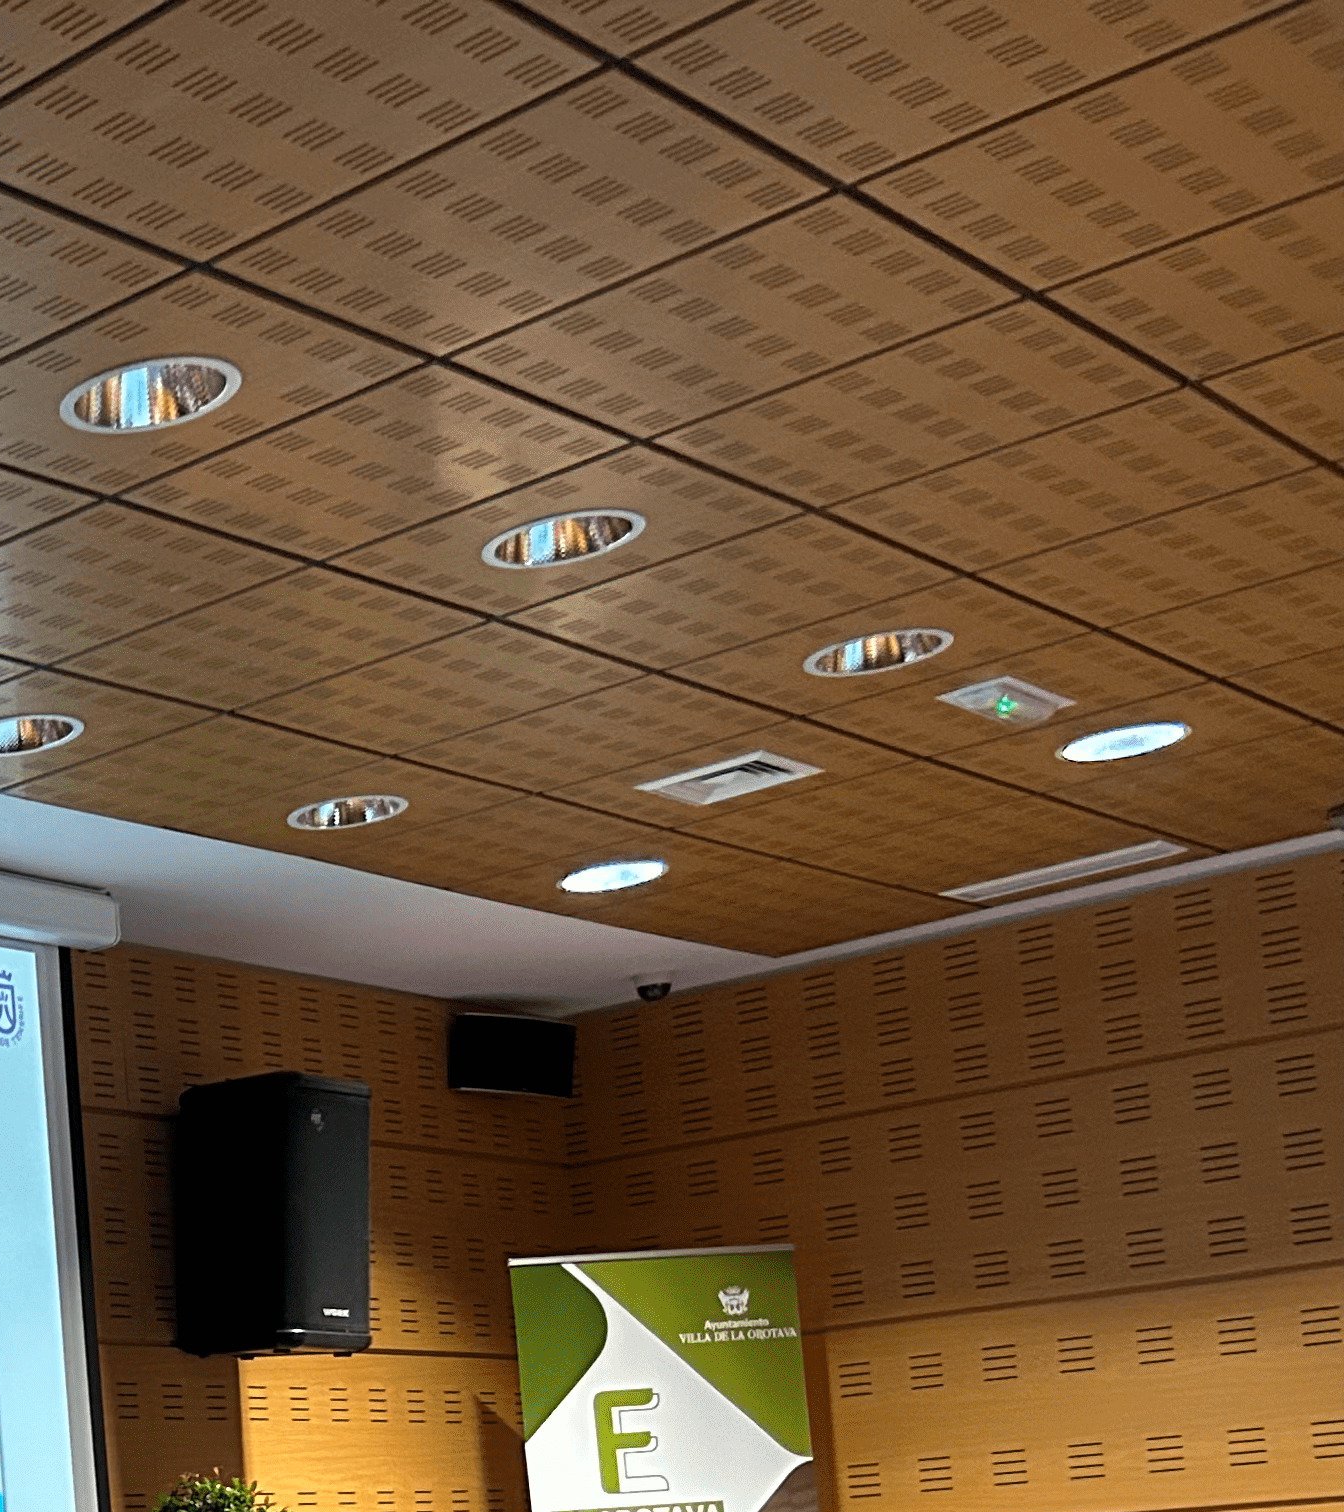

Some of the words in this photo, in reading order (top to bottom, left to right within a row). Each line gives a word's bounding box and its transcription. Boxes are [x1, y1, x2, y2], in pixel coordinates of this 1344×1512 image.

[678, 1332, 712, 1344] VILLA
[714, 1331, 730, 1342] DE
[730, 1330, 746, 1341] LA
[746, 1327, 798, 1340] OROTAVA
